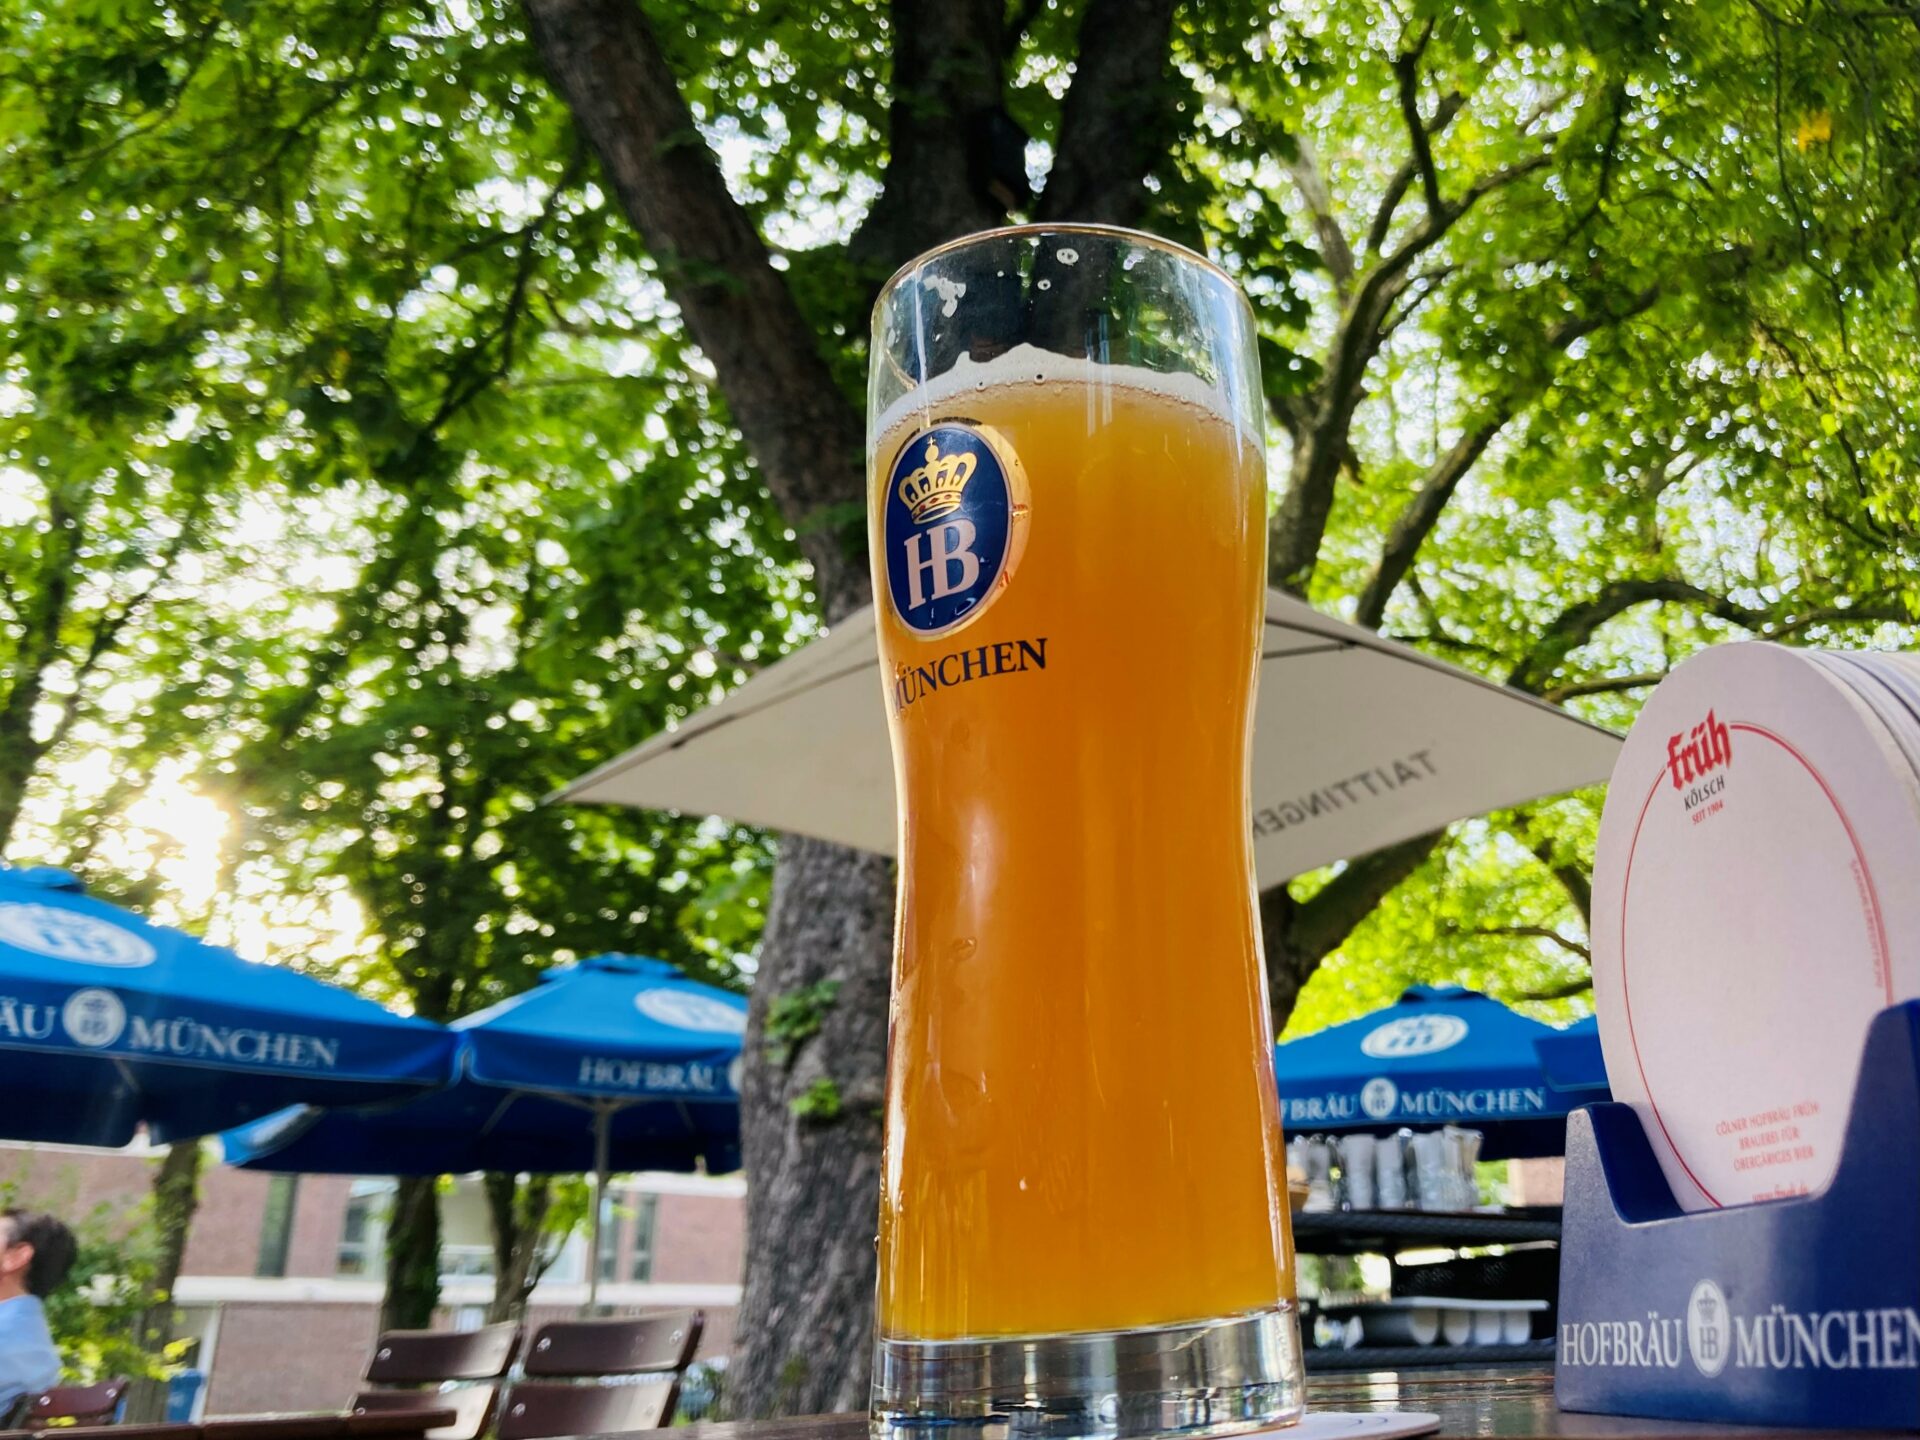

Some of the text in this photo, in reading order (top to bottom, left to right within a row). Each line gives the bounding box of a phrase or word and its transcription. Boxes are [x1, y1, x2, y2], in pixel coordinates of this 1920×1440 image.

[904, 517, 980, 610] HB
[1684, 775, 1725, 811] KÖLSCH
[1691, 809, 1706, 825] SEIT
[130, 1014, 340, 1067] MÜNCHEN
[1401, 1087, 1545, 1114] MÜNCHEN
[1562, 1311, 1682, 1369] HOFBRÄU
